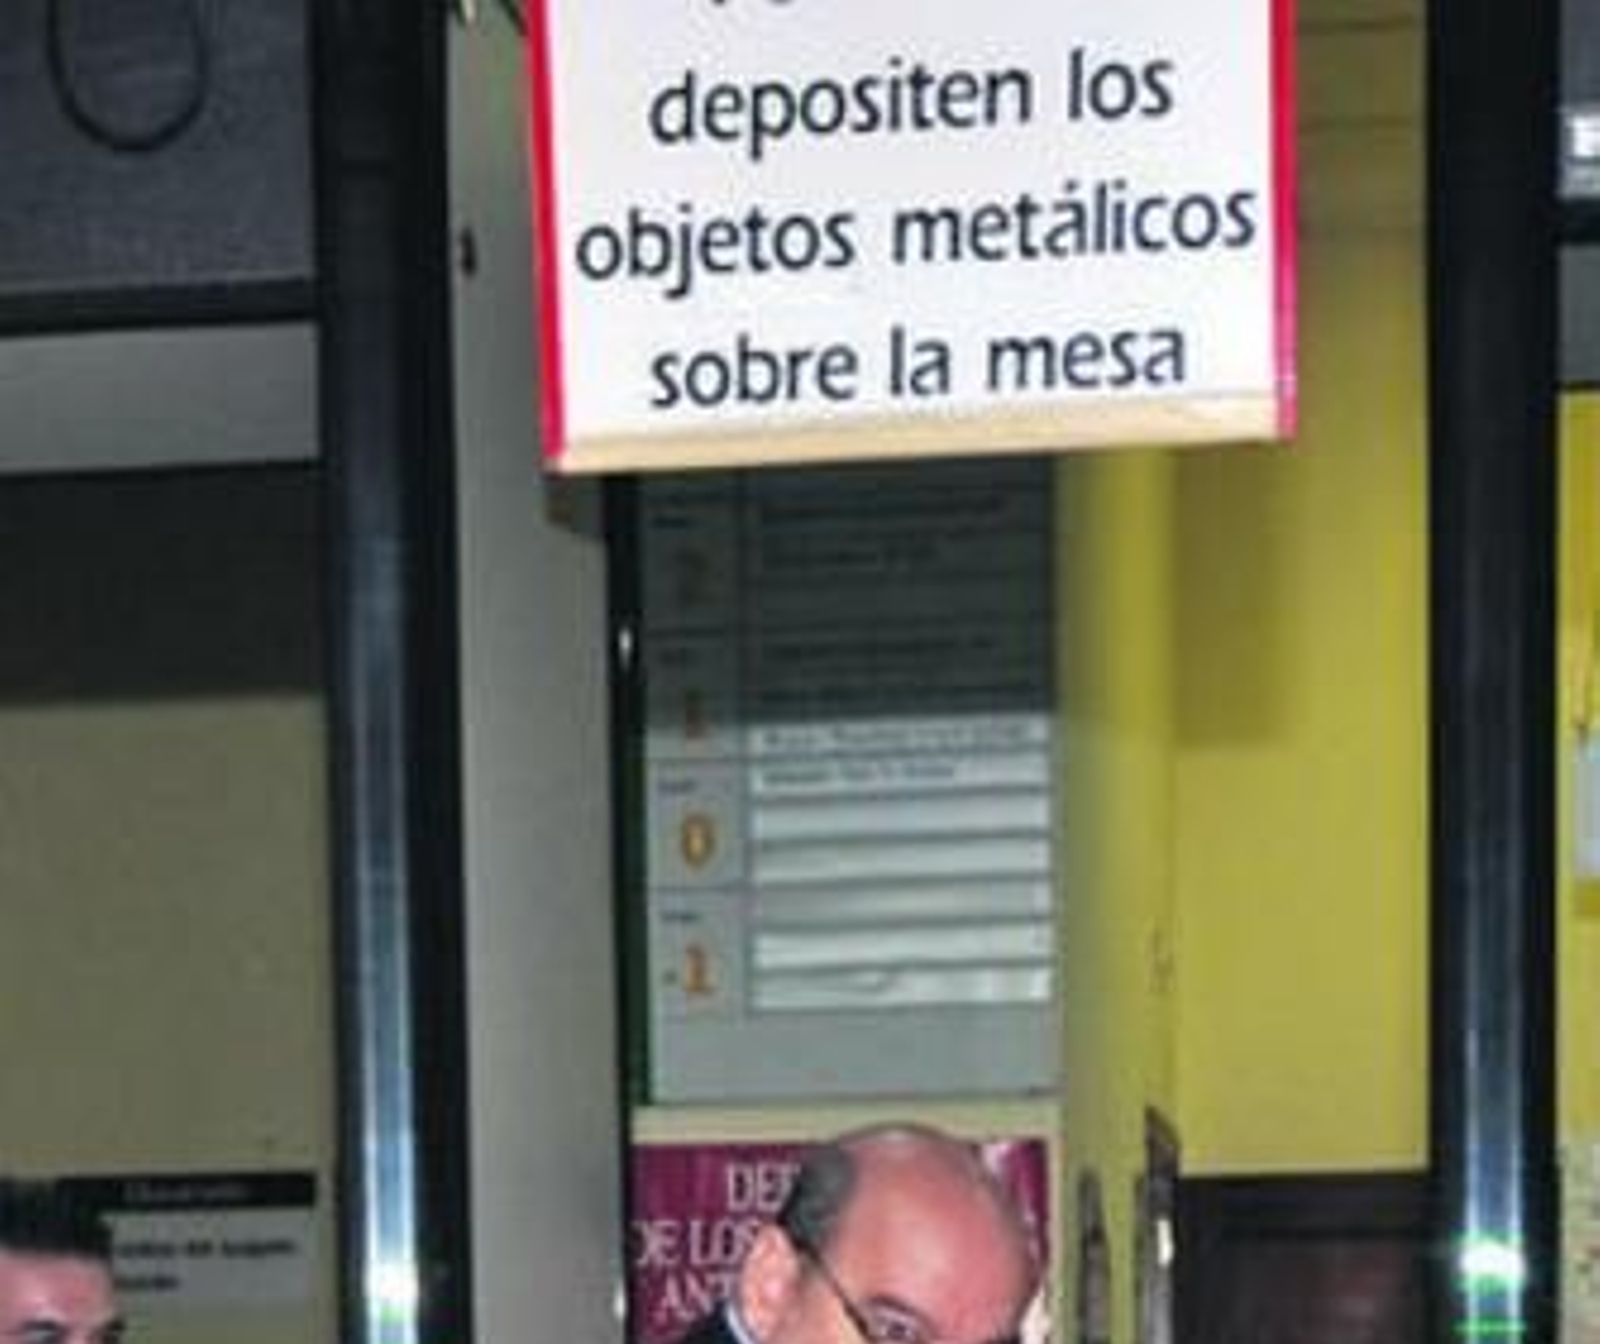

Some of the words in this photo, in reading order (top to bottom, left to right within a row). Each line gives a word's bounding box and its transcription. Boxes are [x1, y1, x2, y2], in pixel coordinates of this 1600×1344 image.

[649, 57, 1032, 162] depositen
[1068, 48, 1172, 120] los
[575, 203, 855, 300] objetos
[893, 180, 1255, 264] metálicos
[652, 335, 858, 409] sobre
[890, 327, 950, 396] la
[989, 330, 1184, 390] mesa
[680, 812, 716, 870] 0
